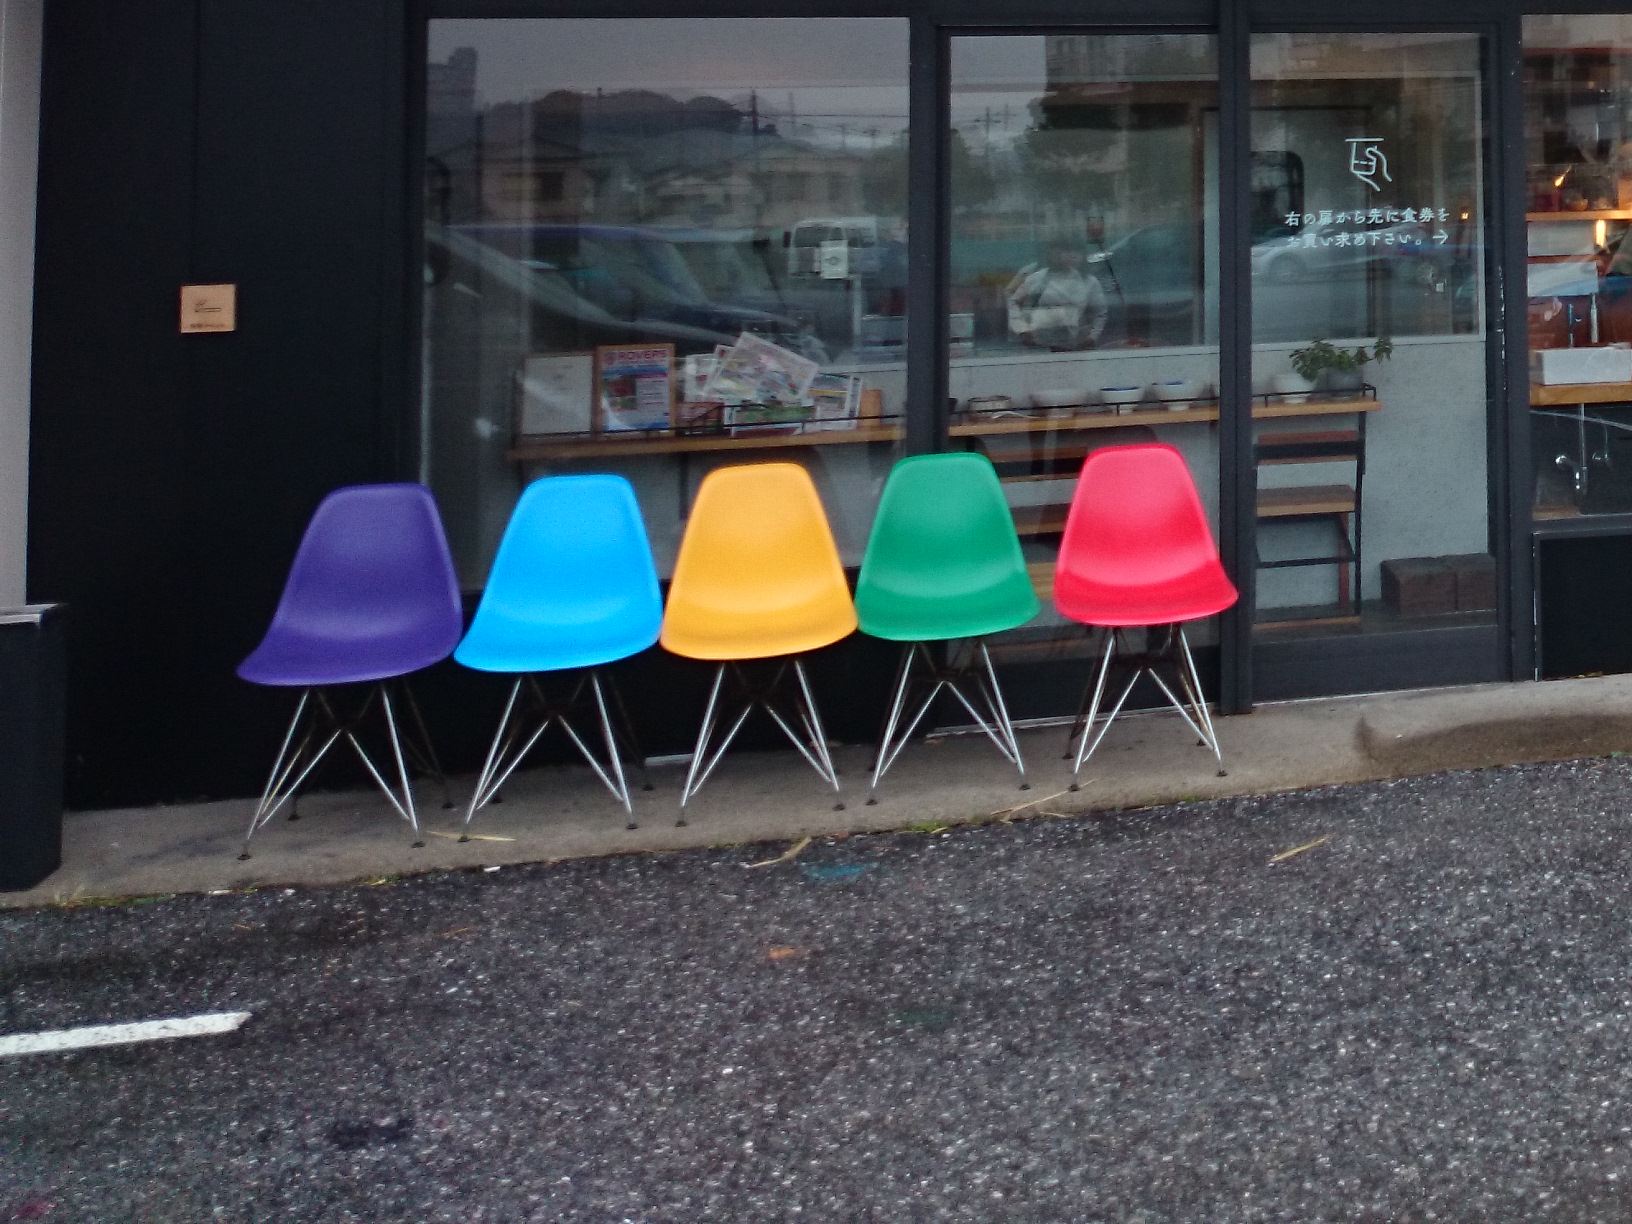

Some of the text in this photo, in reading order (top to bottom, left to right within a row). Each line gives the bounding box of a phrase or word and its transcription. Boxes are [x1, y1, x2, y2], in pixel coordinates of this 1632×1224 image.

[1285, 207, 1450, 226] 右の扉から先に食券を
